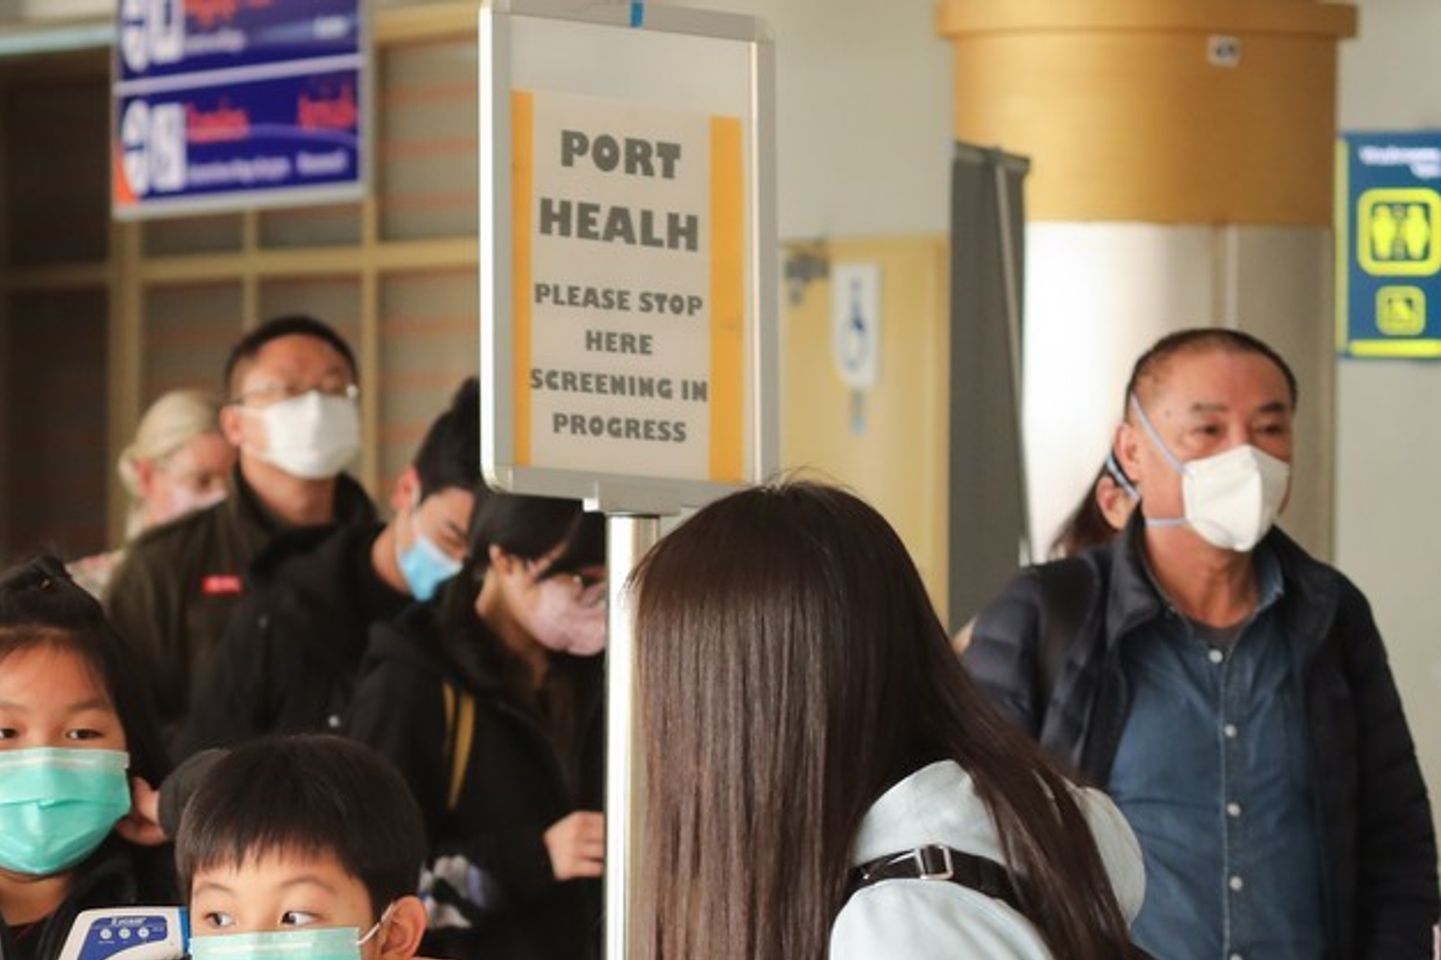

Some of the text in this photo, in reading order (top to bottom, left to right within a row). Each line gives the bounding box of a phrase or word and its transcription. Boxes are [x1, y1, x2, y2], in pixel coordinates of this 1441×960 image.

[561, 130, 682, 179] PORT
[540, 197, 698, 251] HEALH
[534, 283, 703, 316] PLEASE STOP
[585, 330, 653, 354] HERE
[530, 368, 708, 402] SCREENING IN
[553, 413, 686, 443] PROGRESS
